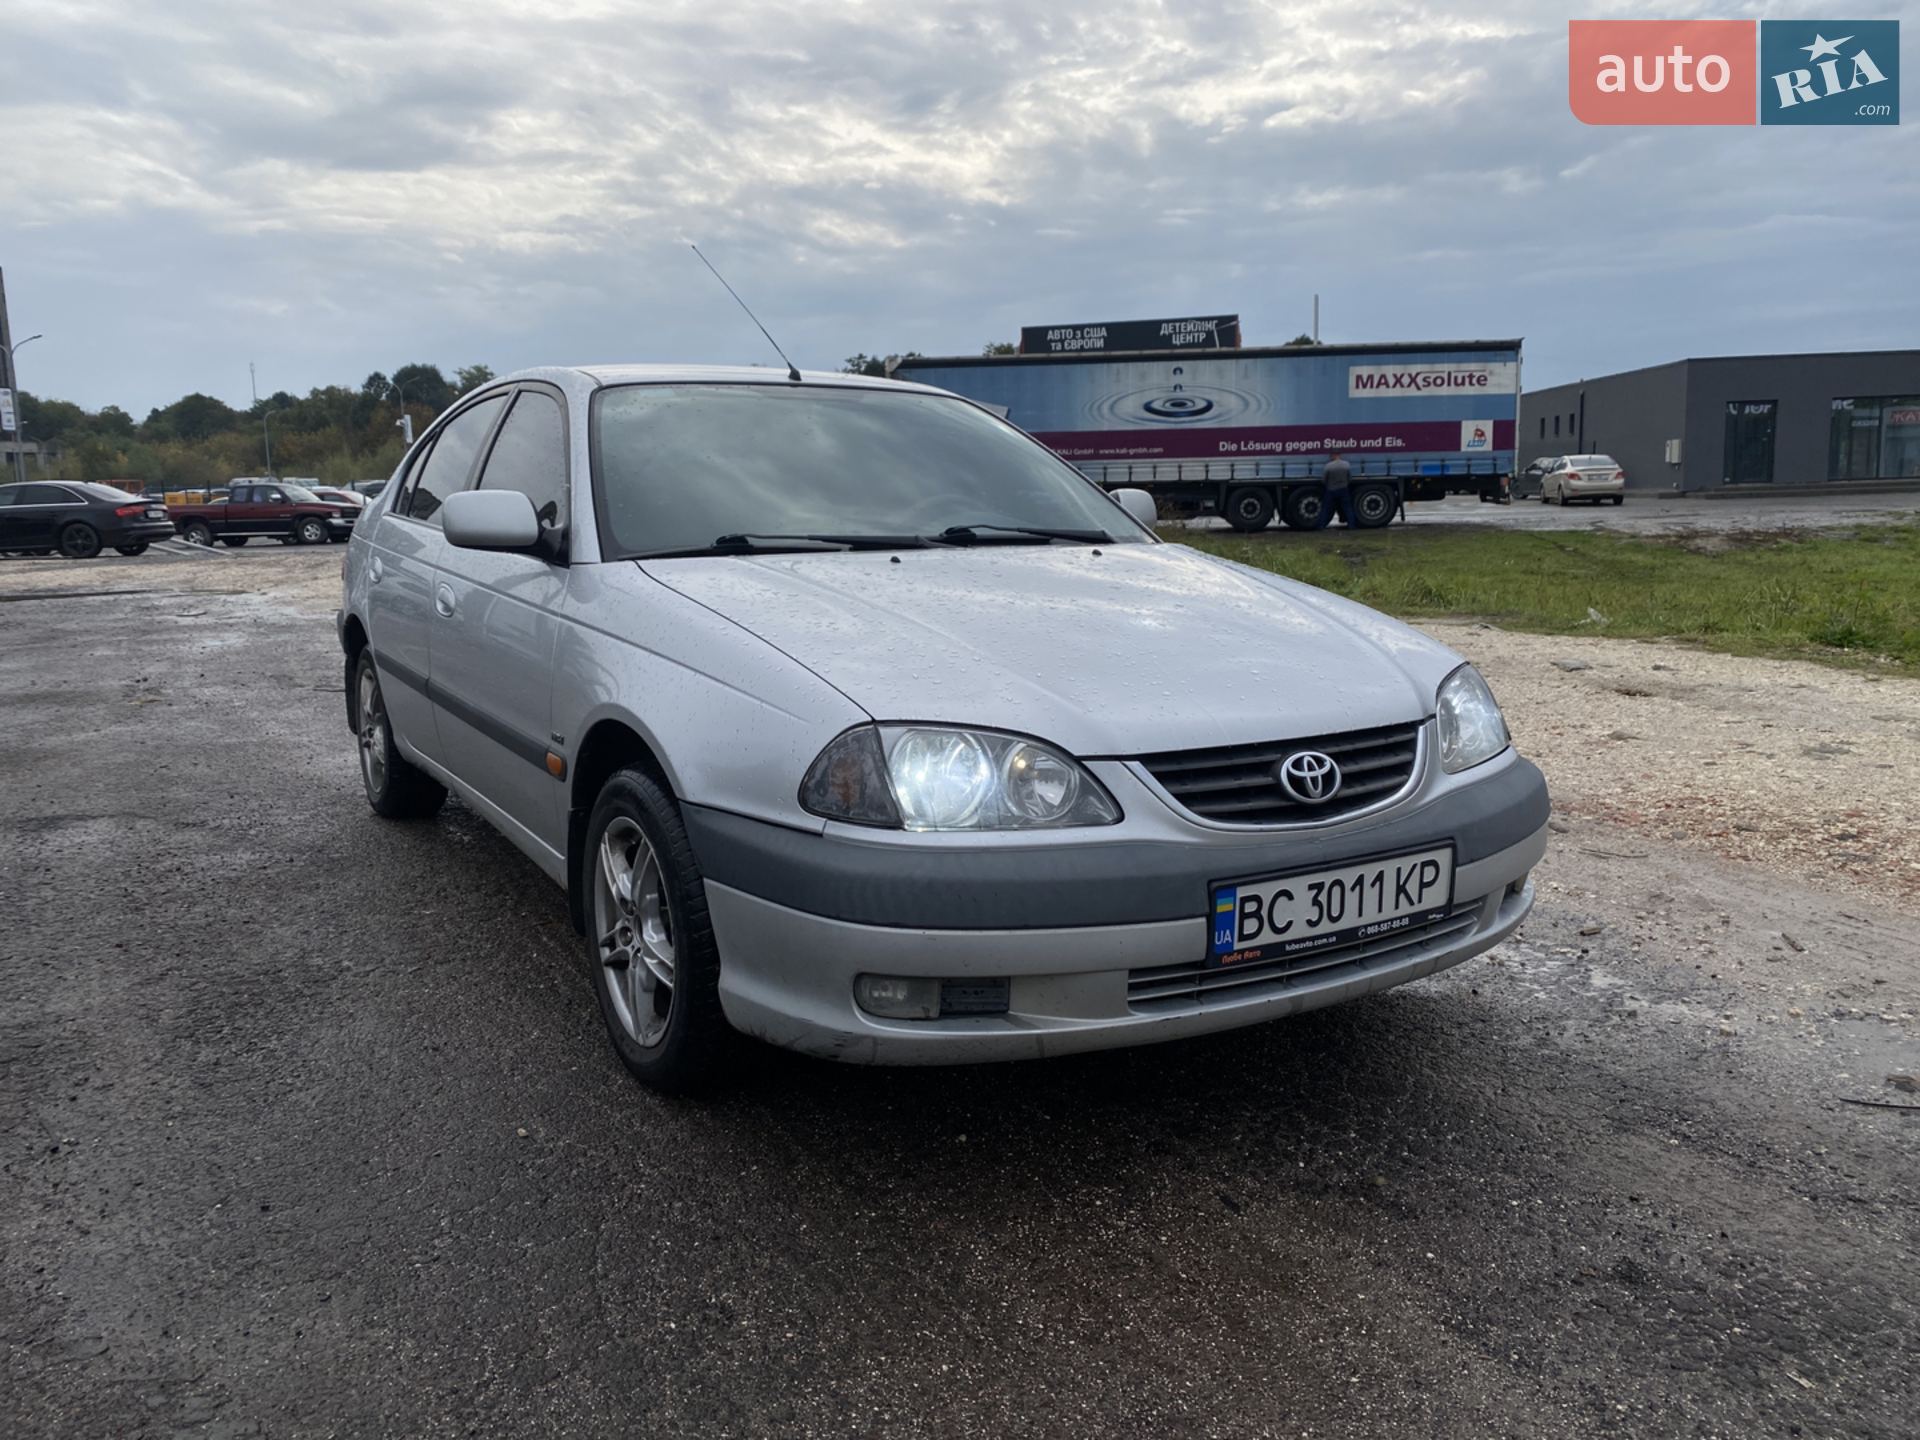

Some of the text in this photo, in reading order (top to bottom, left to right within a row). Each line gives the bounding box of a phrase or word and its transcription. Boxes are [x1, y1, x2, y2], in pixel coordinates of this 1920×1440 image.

[1047, 328, 1073, 341] АВТО
[1083, 326, 1107, 338] США
[1172, 332, 1206, 346] ЦЕНТР
[1050, 338, 1105, 350] та ЄВРОПИ
[1355, 370, 1488, 391] MAXXsolute
[1219, 436, 1407, 452] Die Lösung gegen Staub und Eis.
[1215, 928, 1232, 945] UA
